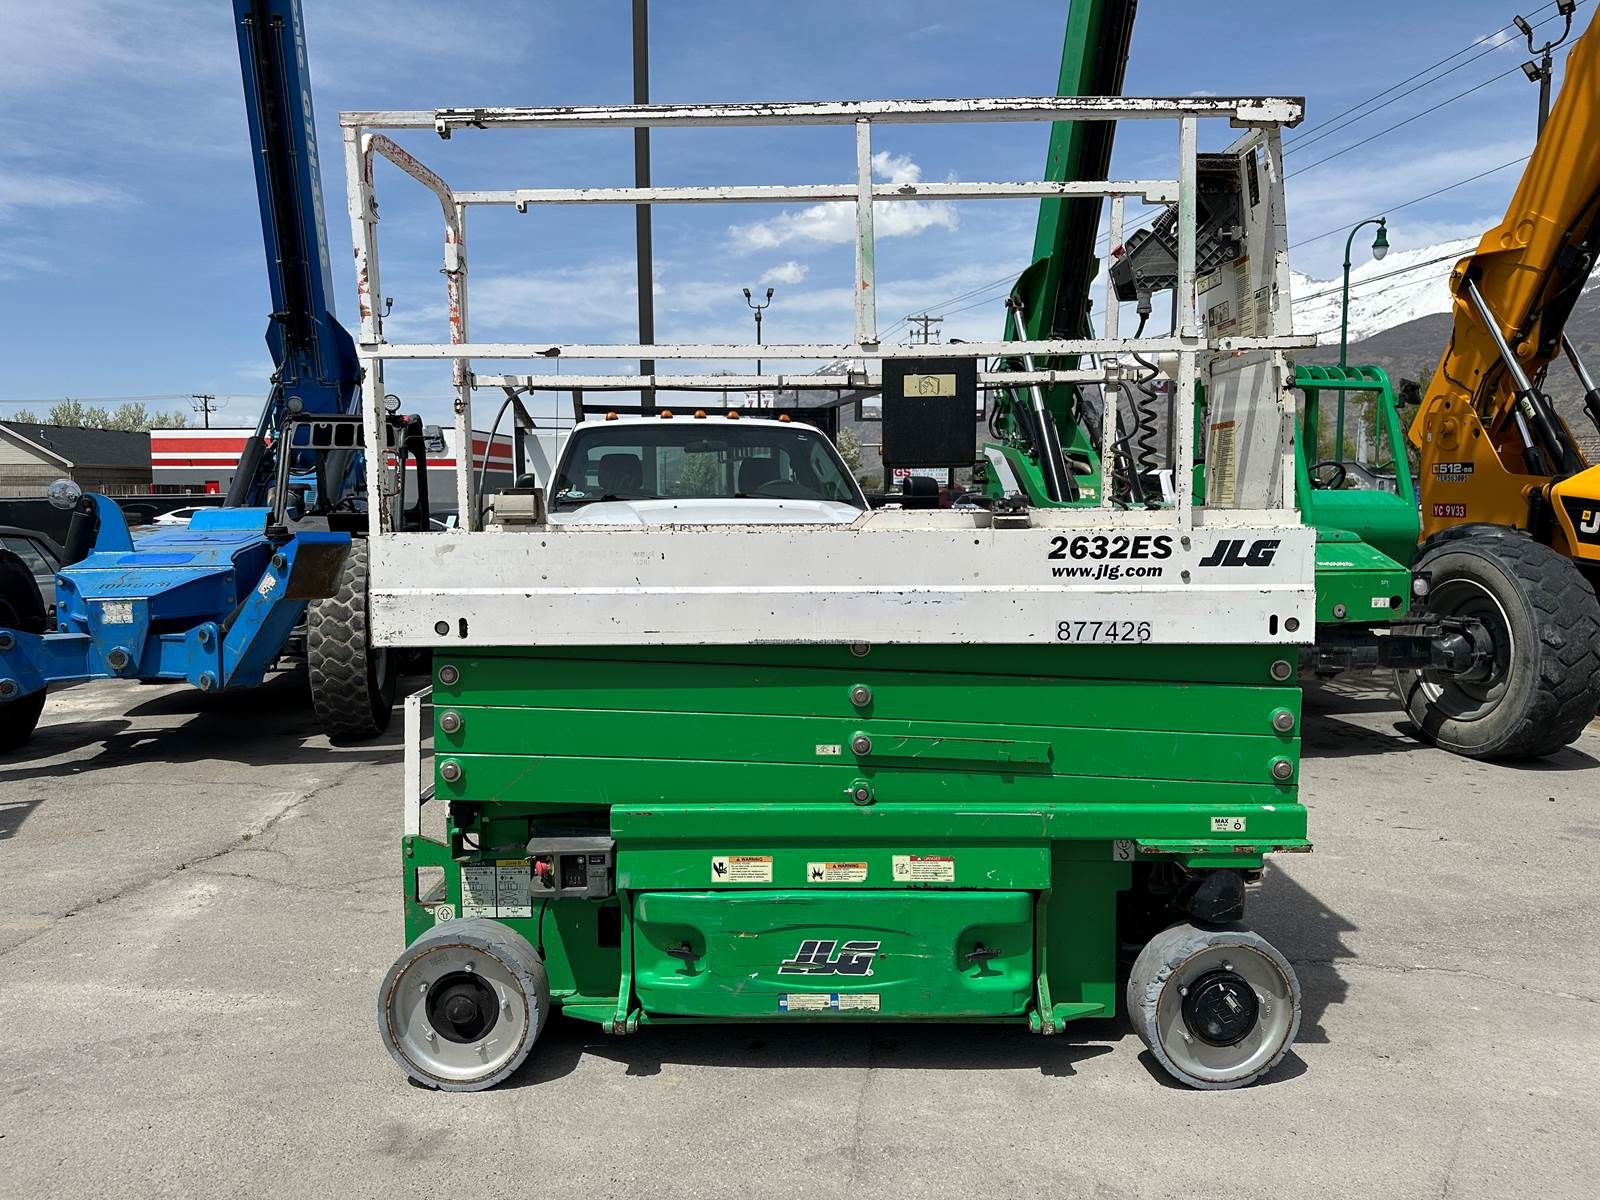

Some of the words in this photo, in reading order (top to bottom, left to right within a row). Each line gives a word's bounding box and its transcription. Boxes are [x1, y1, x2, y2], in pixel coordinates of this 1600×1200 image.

[1047, 535, 1173, 560] 2632ES
[1198, 539, 1281, 567] JLG
[1051, 564, 1163, 580] www.jlg.com
[1057, 621, 1151, 642] 877426
[778, 939, 881, 976] JLG
